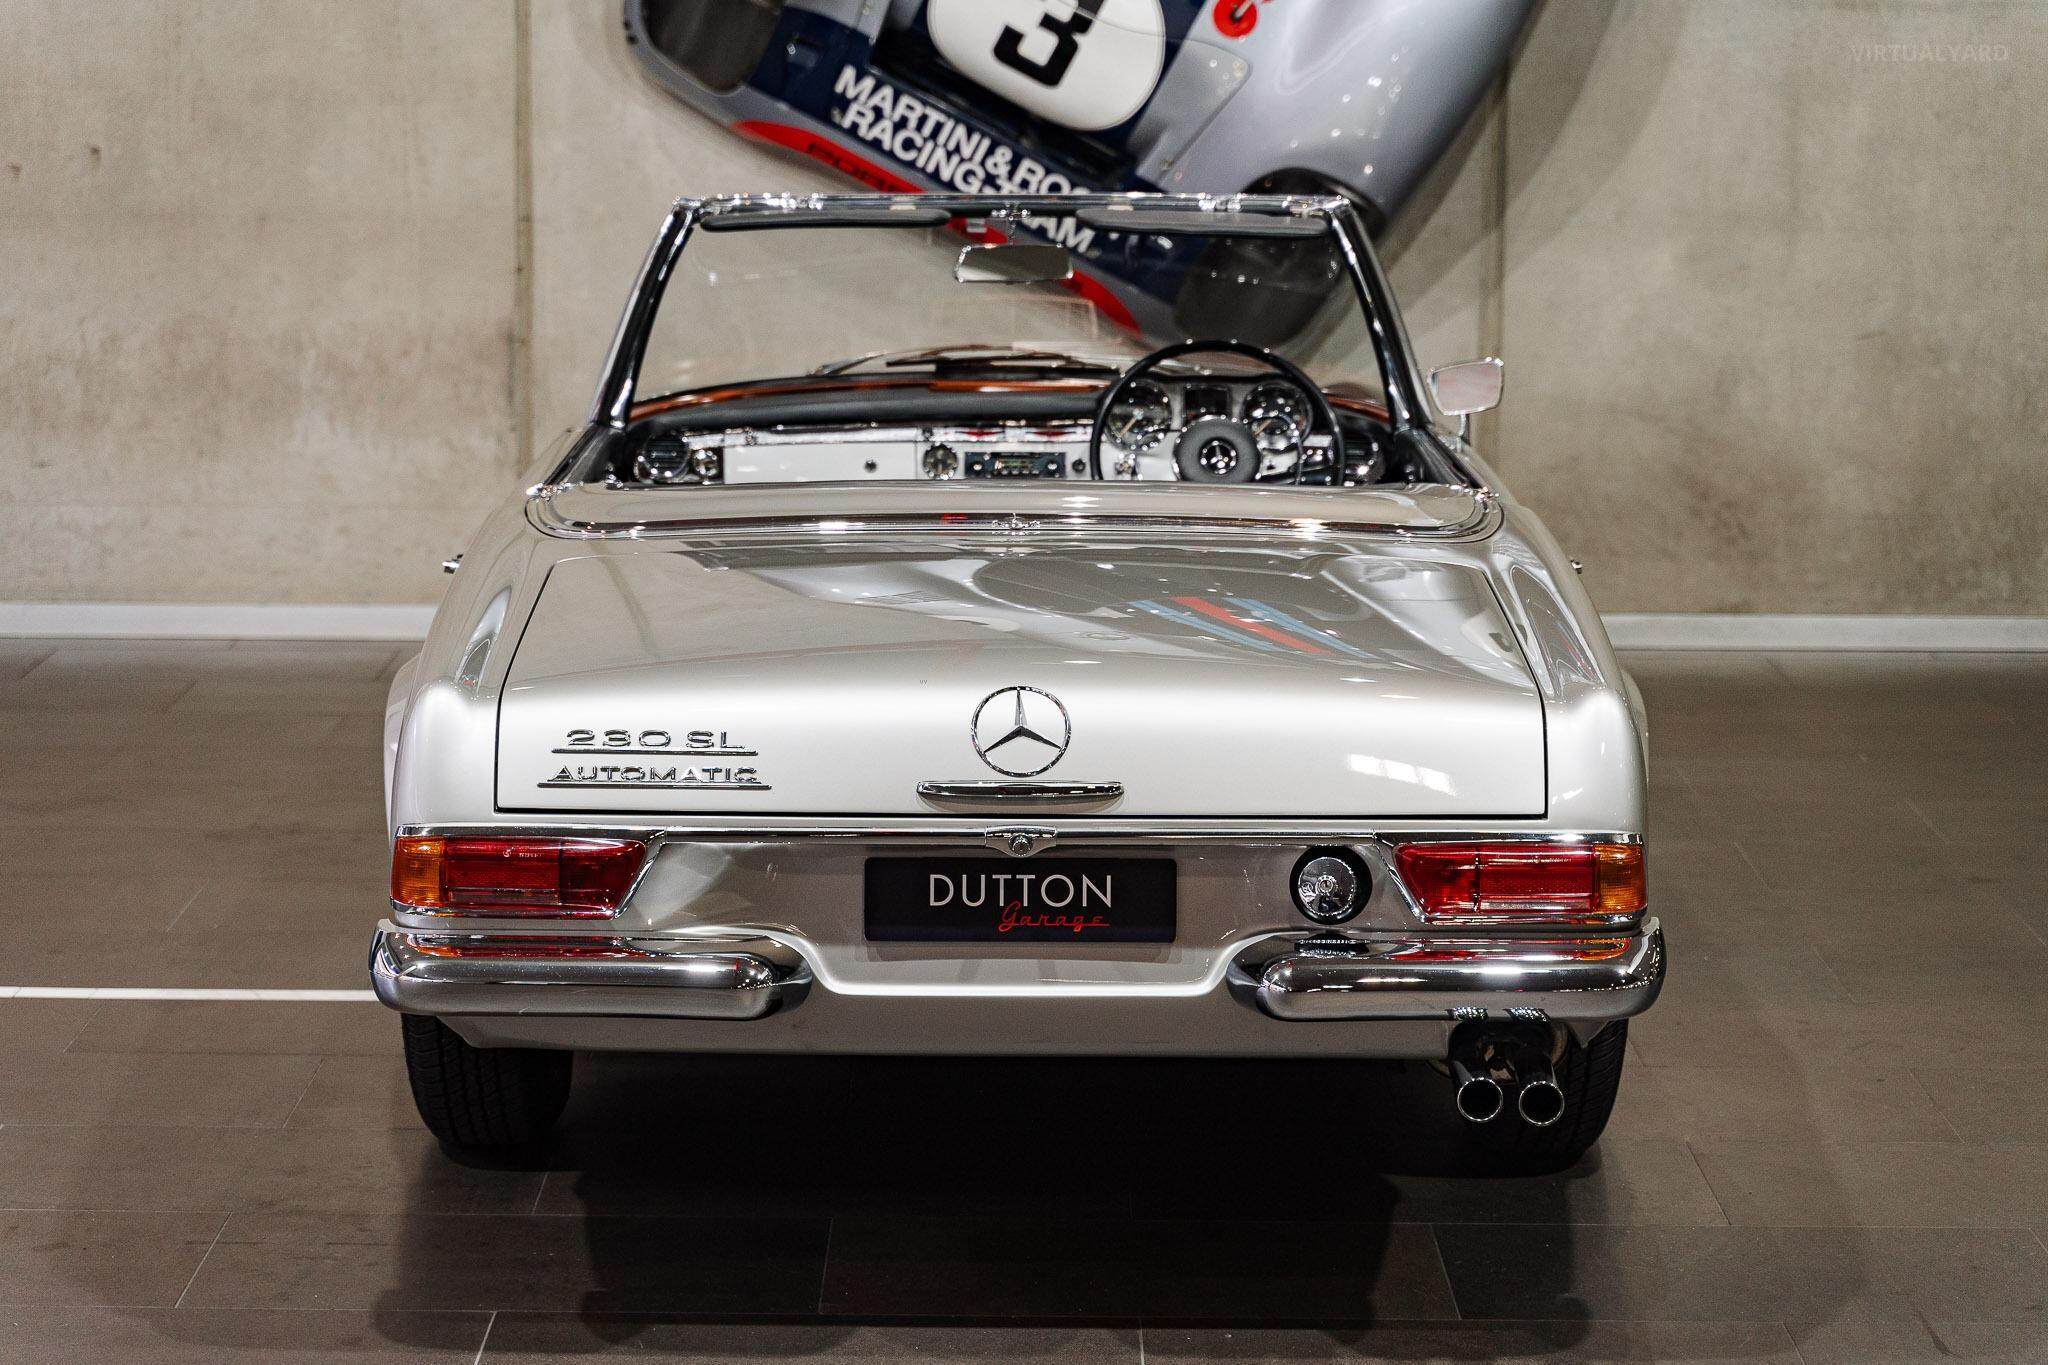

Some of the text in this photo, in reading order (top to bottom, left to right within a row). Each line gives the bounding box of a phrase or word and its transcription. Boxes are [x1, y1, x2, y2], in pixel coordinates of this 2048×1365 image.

[993, 0, 1104, 87] 3
[841, 102, 1096, 253] RACING-TAM
[566, 729, 745, 749] 230 SL
[548, 766, 760, 783] AUTOMATIC
[929, 874, 1112, 908] DUTTON
[998, 901, 1111, 932] Garage
